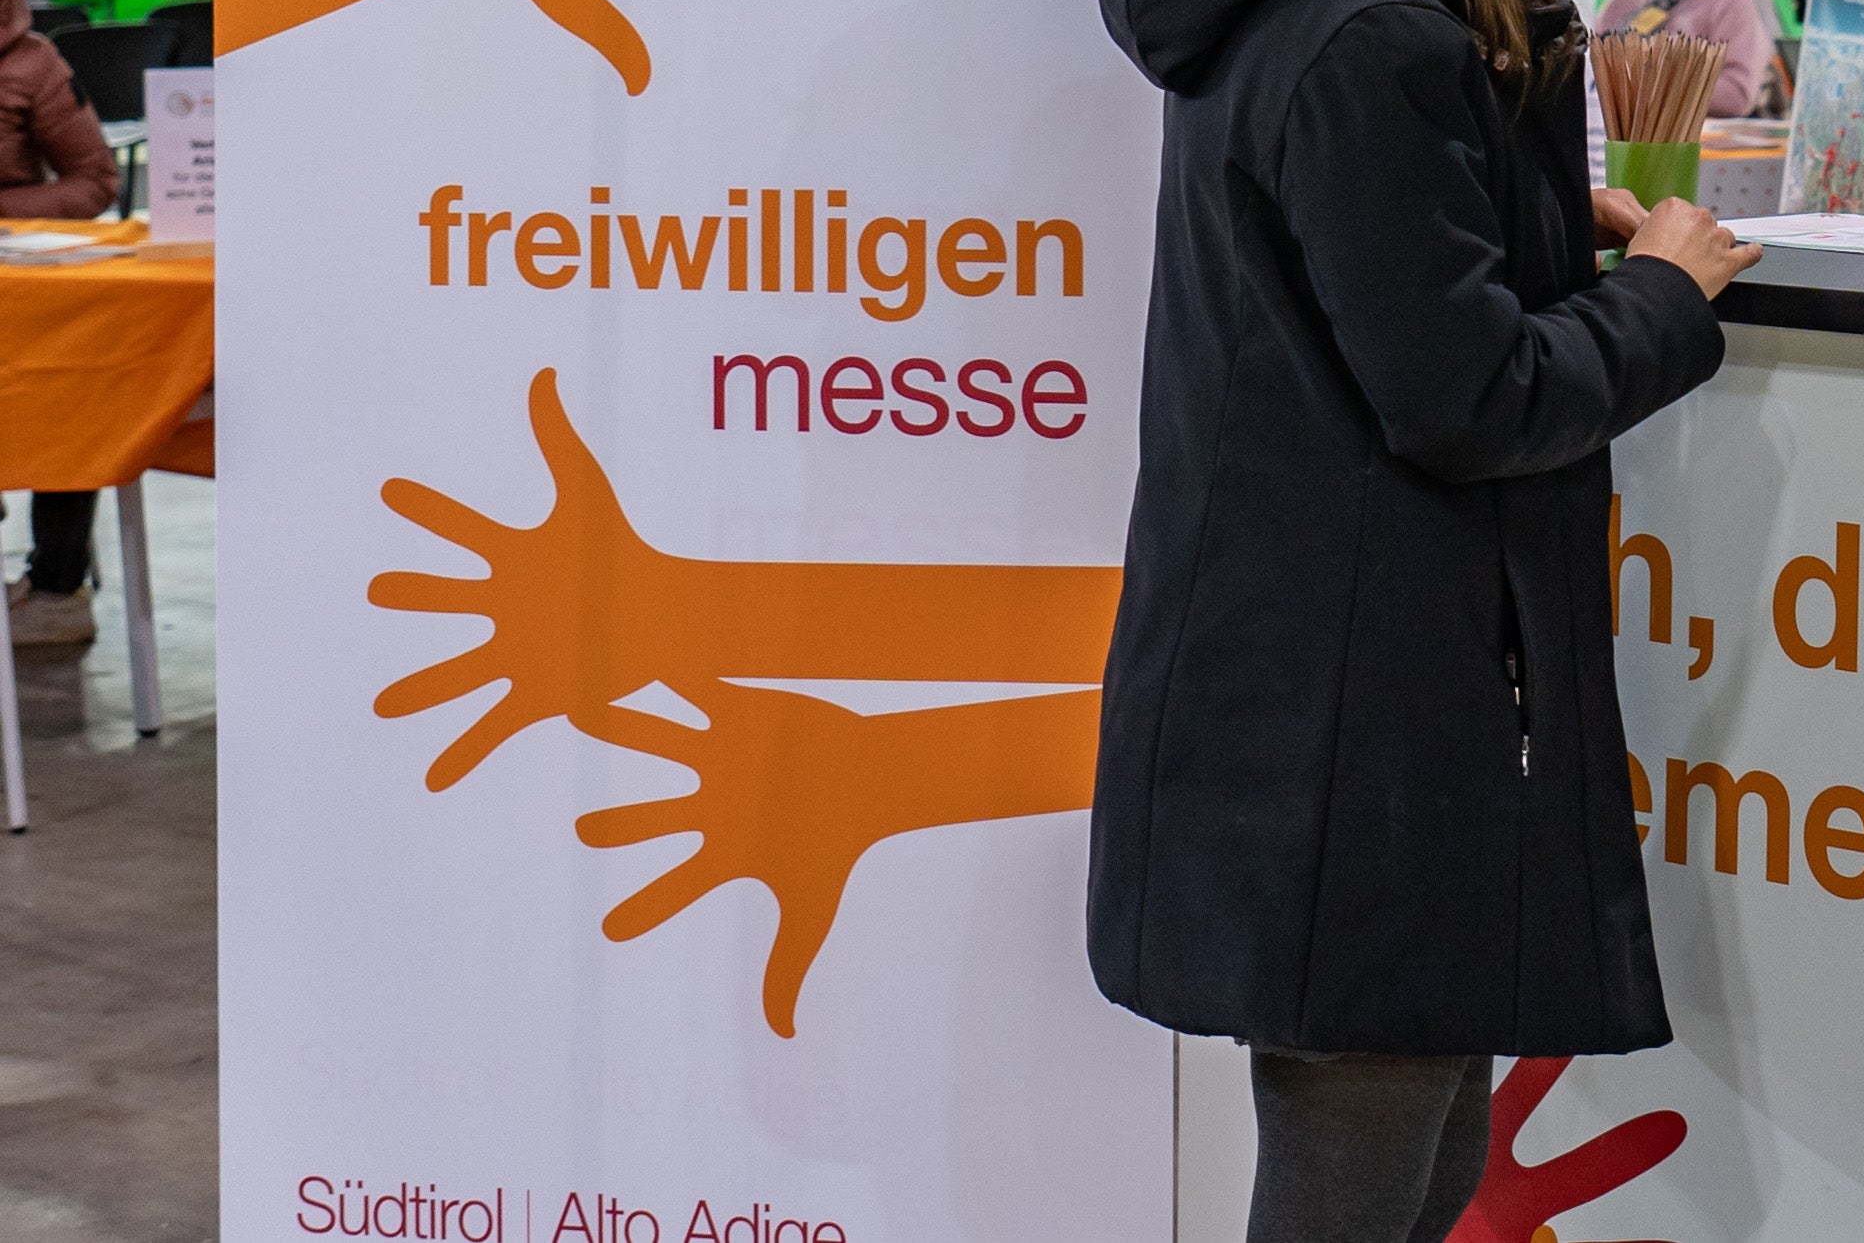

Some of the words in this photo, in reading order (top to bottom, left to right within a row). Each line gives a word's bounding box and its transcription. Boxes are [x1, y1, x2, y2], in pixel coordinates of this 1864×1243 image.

[418, 184, 1084, 323] freiwilligen
[712, 354, 1088, 439] messe
[296, 1176, 502, 1243] Südtirol
[552, 1192, 660, 1243] Alto
